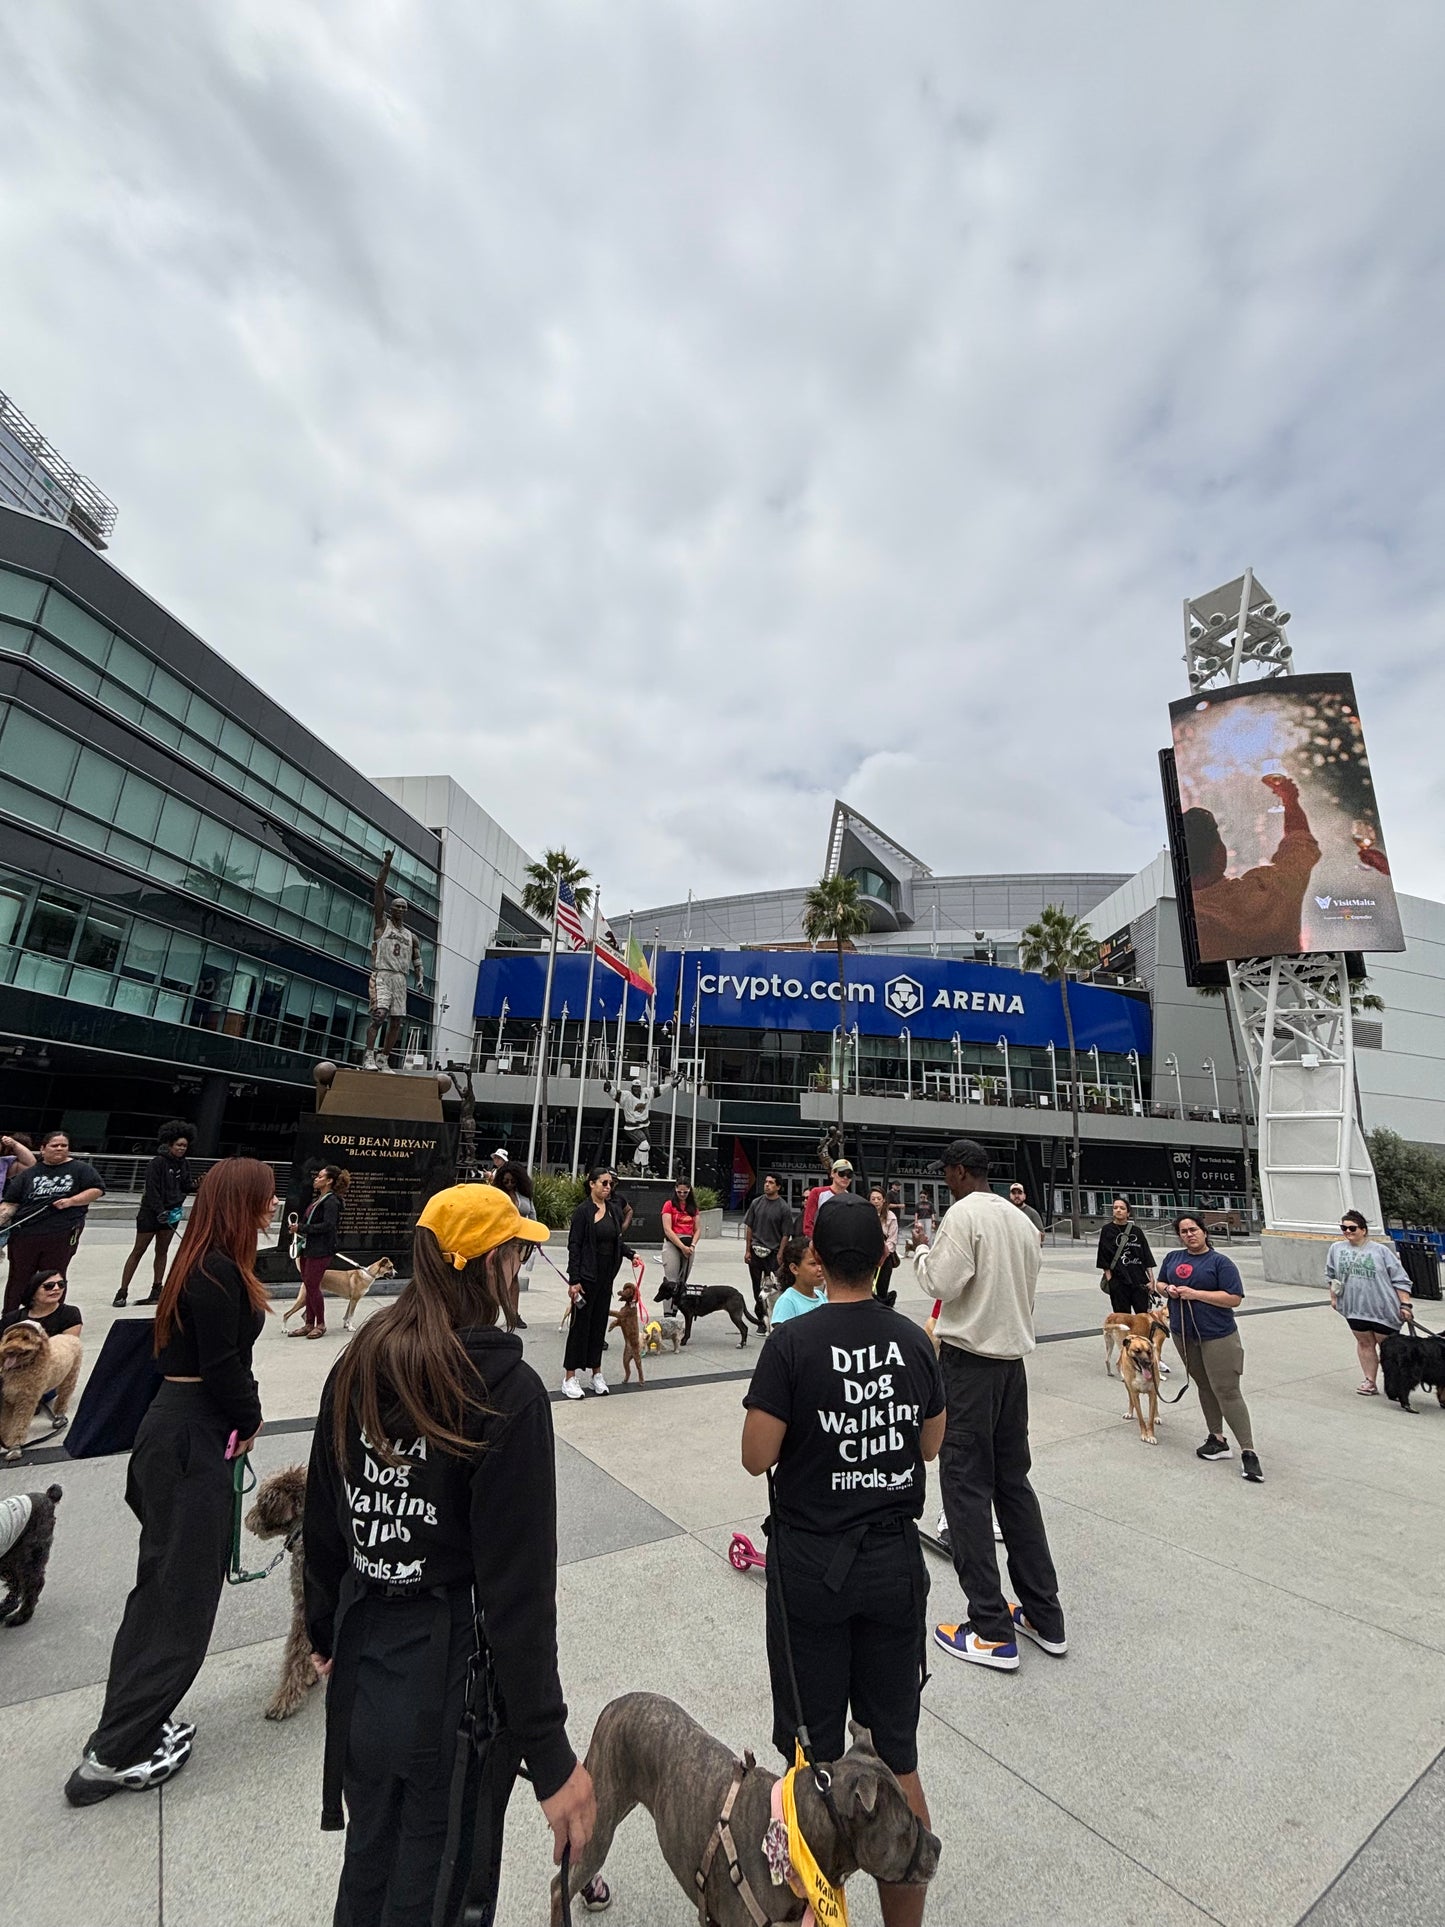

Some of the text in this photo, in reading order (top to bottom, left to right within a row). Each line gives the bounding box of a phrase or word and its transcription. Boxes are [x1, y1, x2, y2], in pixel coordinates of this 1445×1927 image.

[1332, 898, 1376, 907] VisitMalta
[393, 943, 401, 956] 8
[700, 973, 1025, 1015] crypto.com ARENA
[323, 1134, 437, 1149] KOBE BEAN BRYANT
[345, 1148, 414, 1158] "BLACK MAMBA"
[771, 1161, 787, 1169] STAR
[788, 1161, 807, 1169] PLAZA
[1176, 1170, 1236, 1181] BO OFFICE
[831, 1341, 906, 1374] DTLA
[843, 1374, 894, 1404] Dog
[360, 1424, 427, 1461] DLA
[839, 1426, 904, 1463] Club
[363, 1453, 412, 1488] Dog
[831, 1468, 888, 1490] FitPals
[352, 1518, 411, 1547] Club
[353, 1546, 392, 1580] FitPals
[818, 1898, 838, 1919] Club
